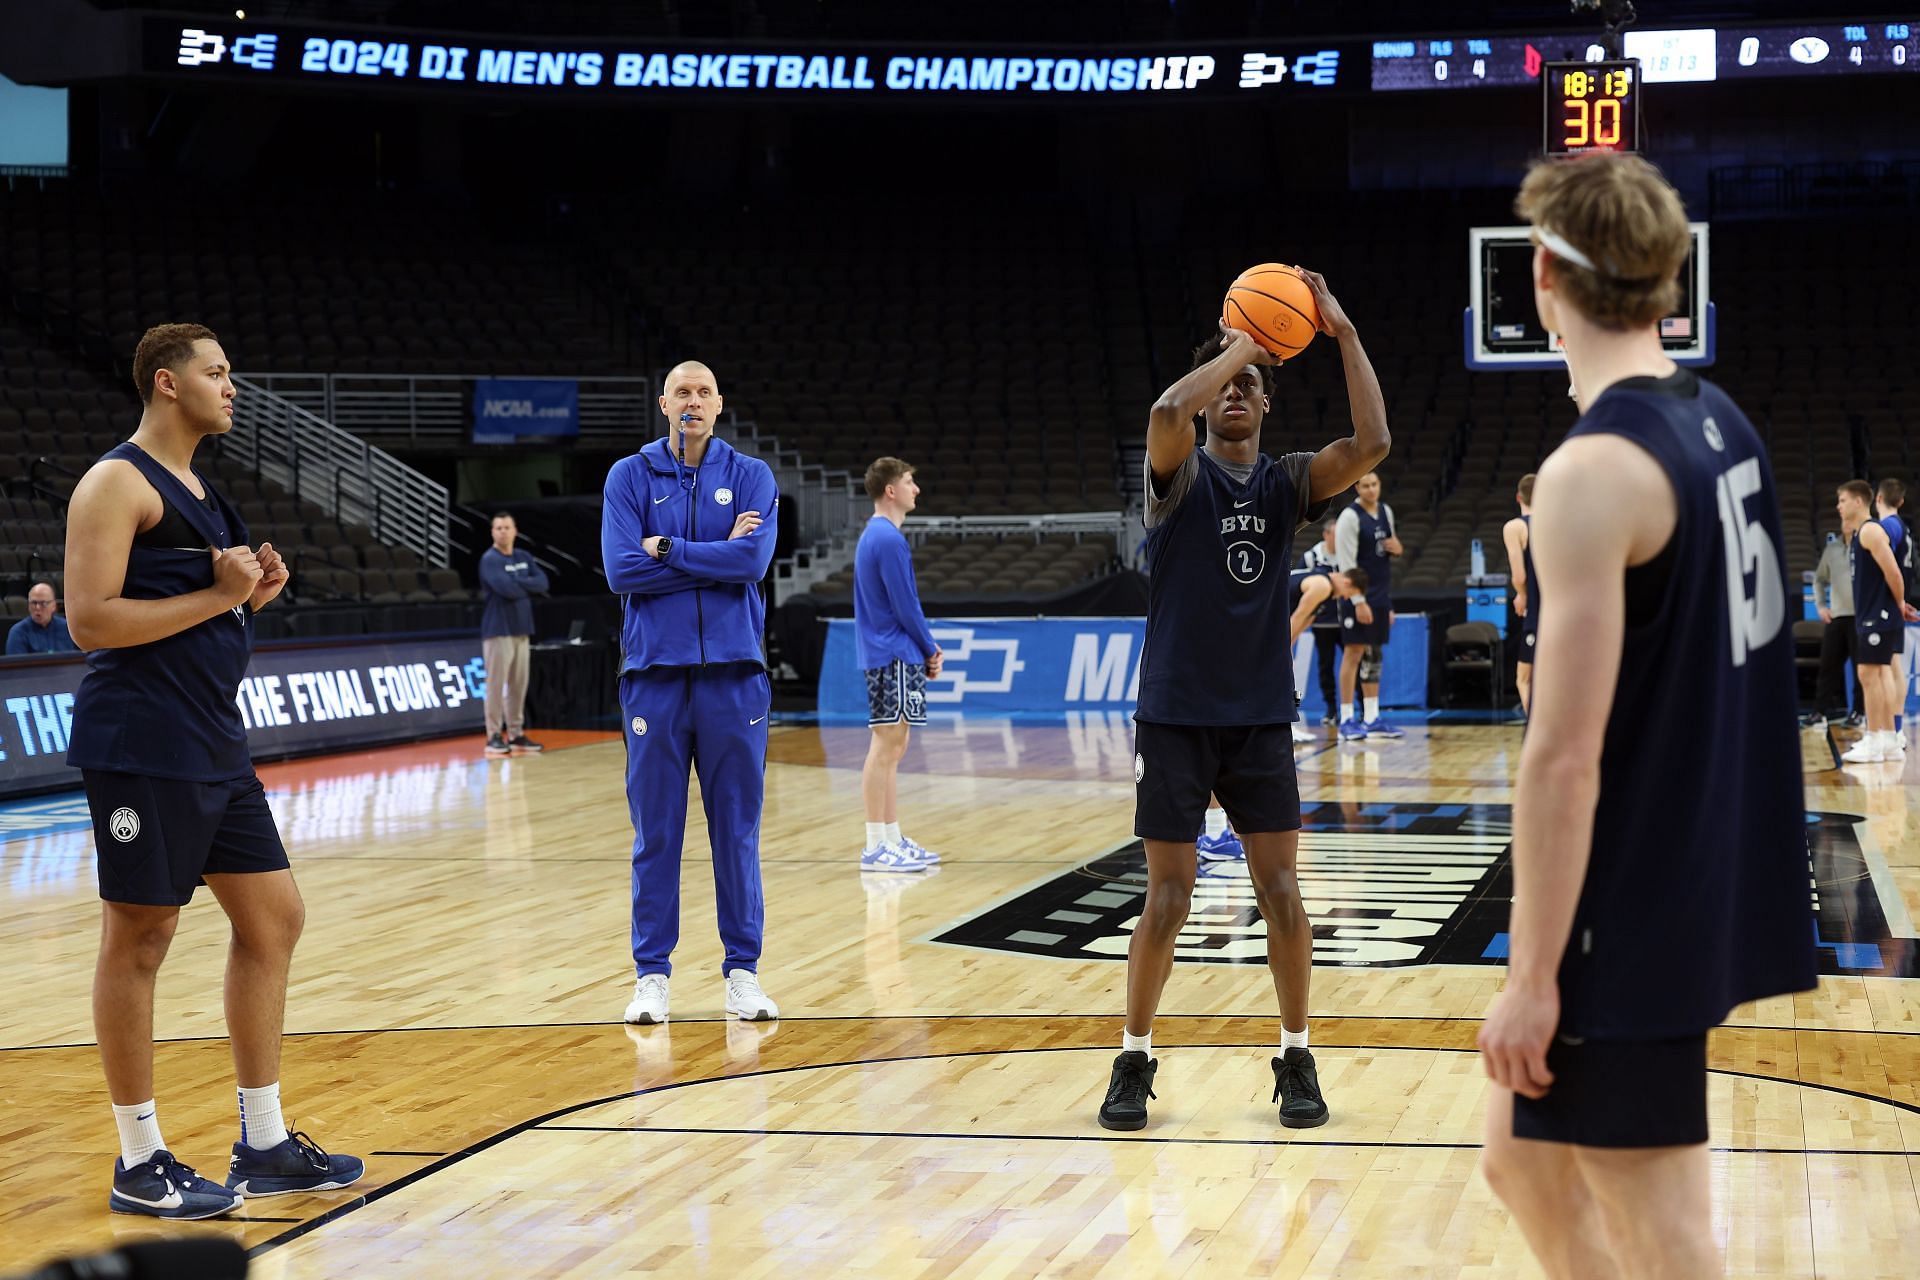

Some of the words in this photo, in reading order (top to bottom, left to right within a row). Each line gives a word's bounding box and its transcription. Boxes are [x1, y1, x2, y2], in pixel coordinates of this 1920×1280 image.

[1886, 25, 1910, 39] FLS
[302, 38, 409, 76] 2024
[419, 46, 469, 80] DI
[477, 50, 603, 86] MEN'S
[614, 53, 874, 89] BASKETBALL
[886, 56, 1215, 91] CHAMPIONSHIP
[1850, 47, 1862, 65] 4
[1892, 45, 1906, 65] 0
[1434, 60, 1448, 80] 0
[1472, 59, 1485, 78] 4
[1564, 70, 1628, 97] 18:13
[1564, 100, 1620, 145] 30
[1221, 515, 1266, 535] BYU
[1238, 550, 1252, 572] 2
[1717, 456, 1785, 668] 15
[287, 668, 376, 724] FINAL
[369, 663, 442, 714] FOUR
